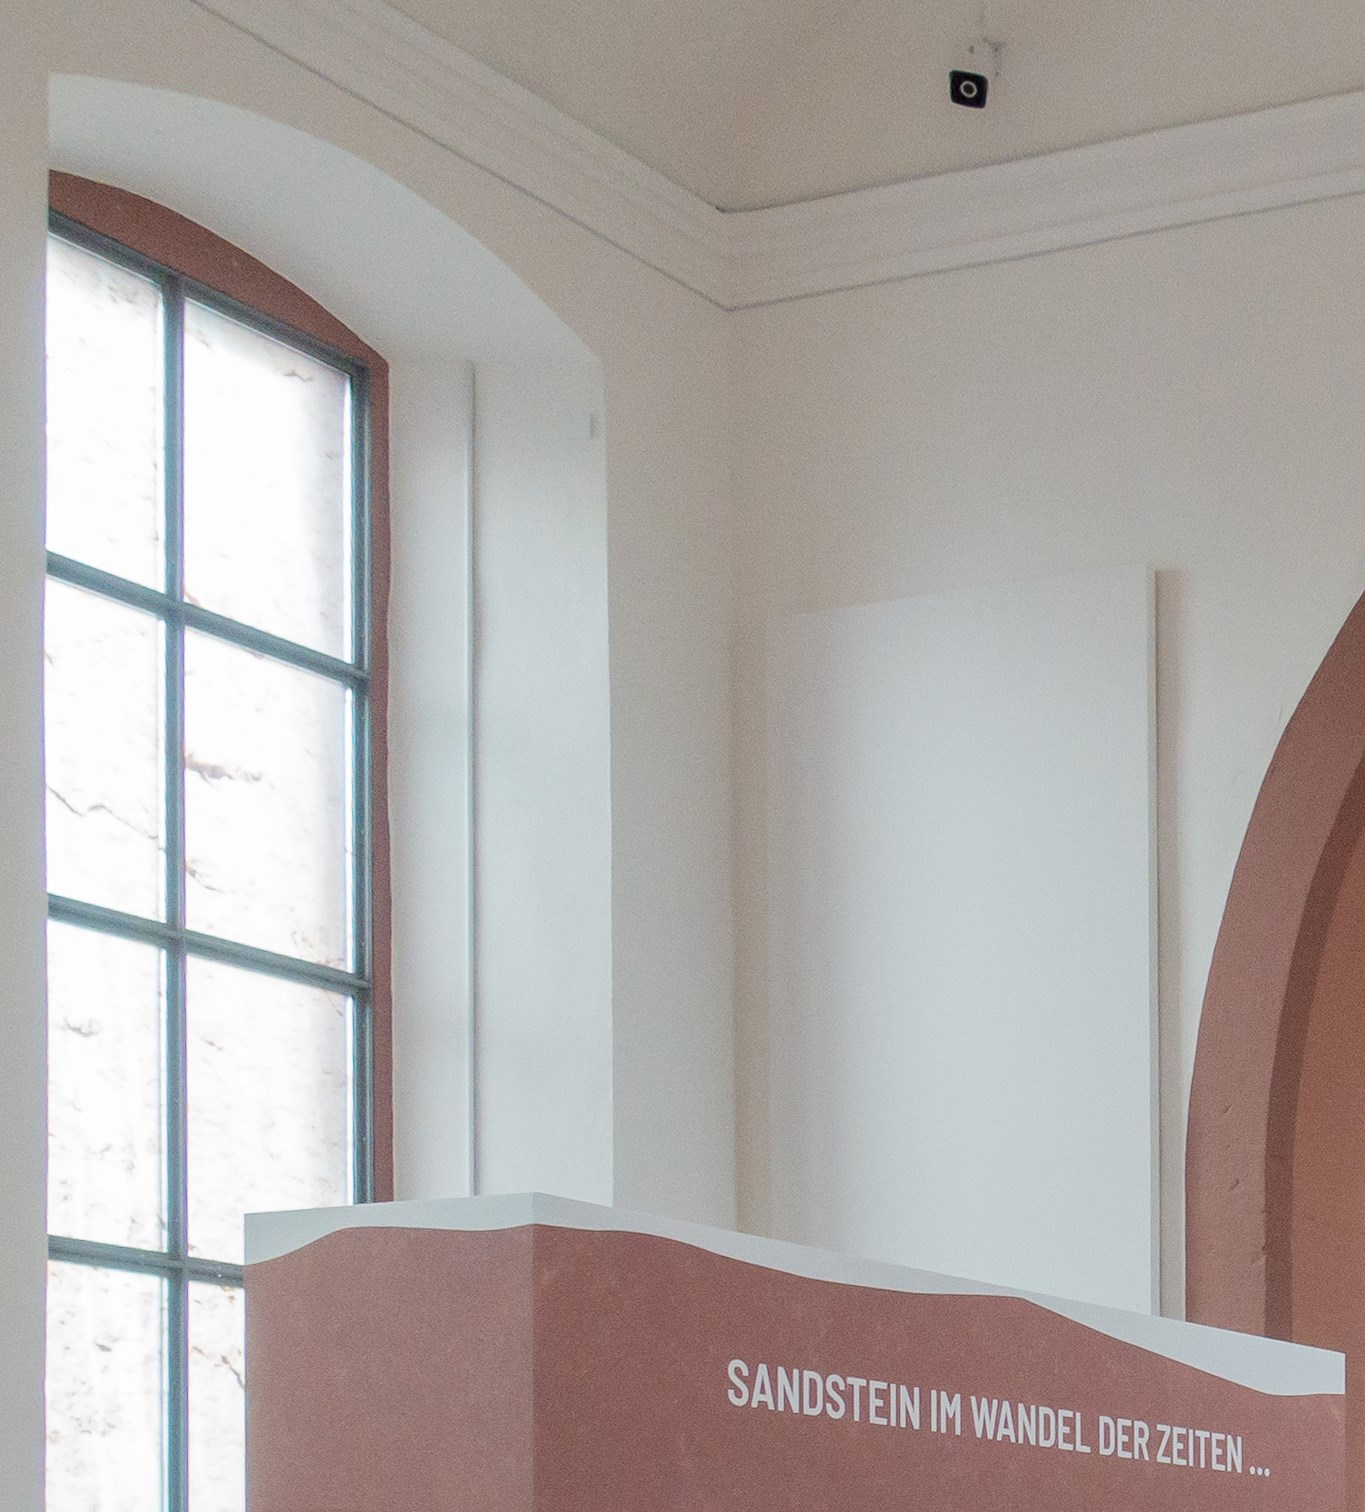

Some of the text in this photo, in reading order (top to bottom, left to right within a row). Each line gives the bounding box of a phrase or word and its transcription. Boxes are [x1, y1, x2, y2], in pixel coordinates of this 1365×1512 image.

[727, 1359, 919, 1429] SANDSTEIN
[930, 1389, 960, 1435] IM
[969, 1395, 1091, 1453] WANDEL
[1098, 1415, 1149, 1461] DER
[1156, 1423, 1242, 1473] ZEITEN
